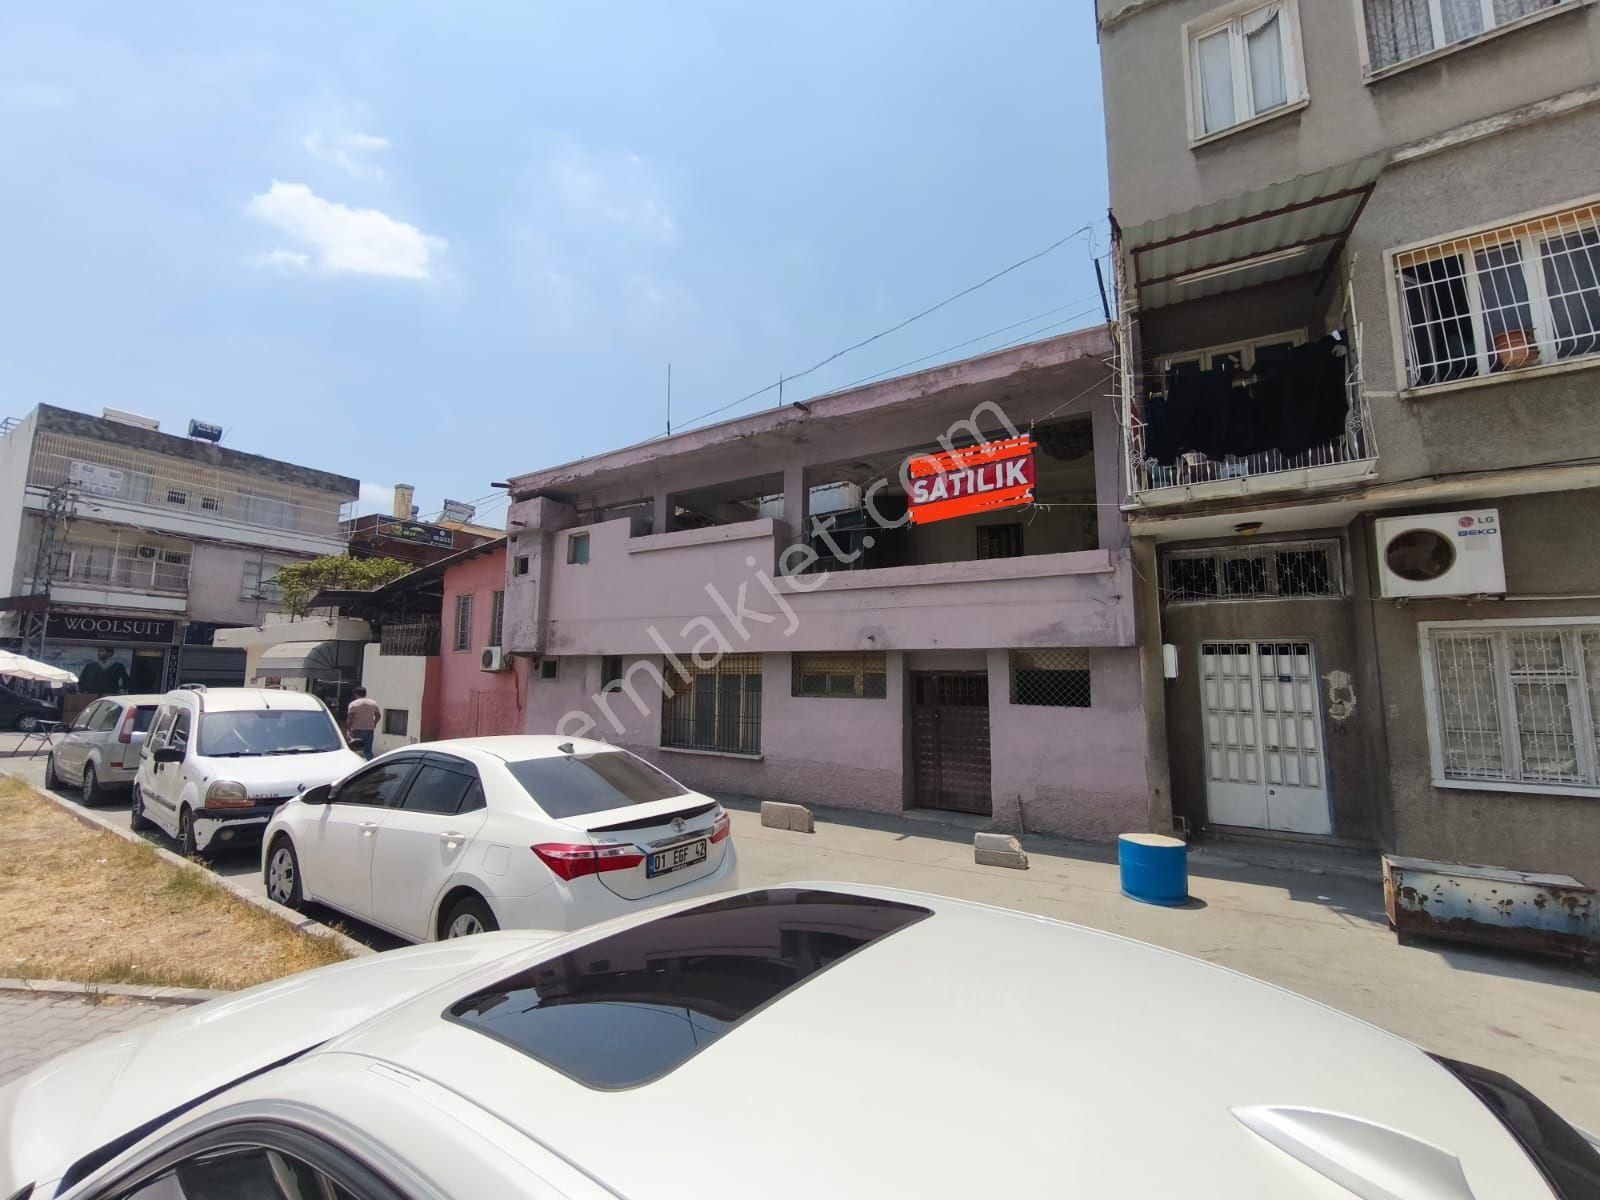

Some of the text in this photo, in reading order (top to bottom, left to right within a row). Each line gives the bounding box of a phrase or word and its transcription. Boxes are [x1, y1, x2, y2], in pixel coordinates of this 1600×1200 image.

[912, 458, 1029, 504] SATILIK
[1477, 516, 1494, 524] LG
[1458, 528, 1497, 537] BEKO
[64, 616, 165, 635] WOOLSUIT
[654, 854, 666, 870] 01
[673, 847, 689, 865] EGF
[695, 842, 705, 857] 42
